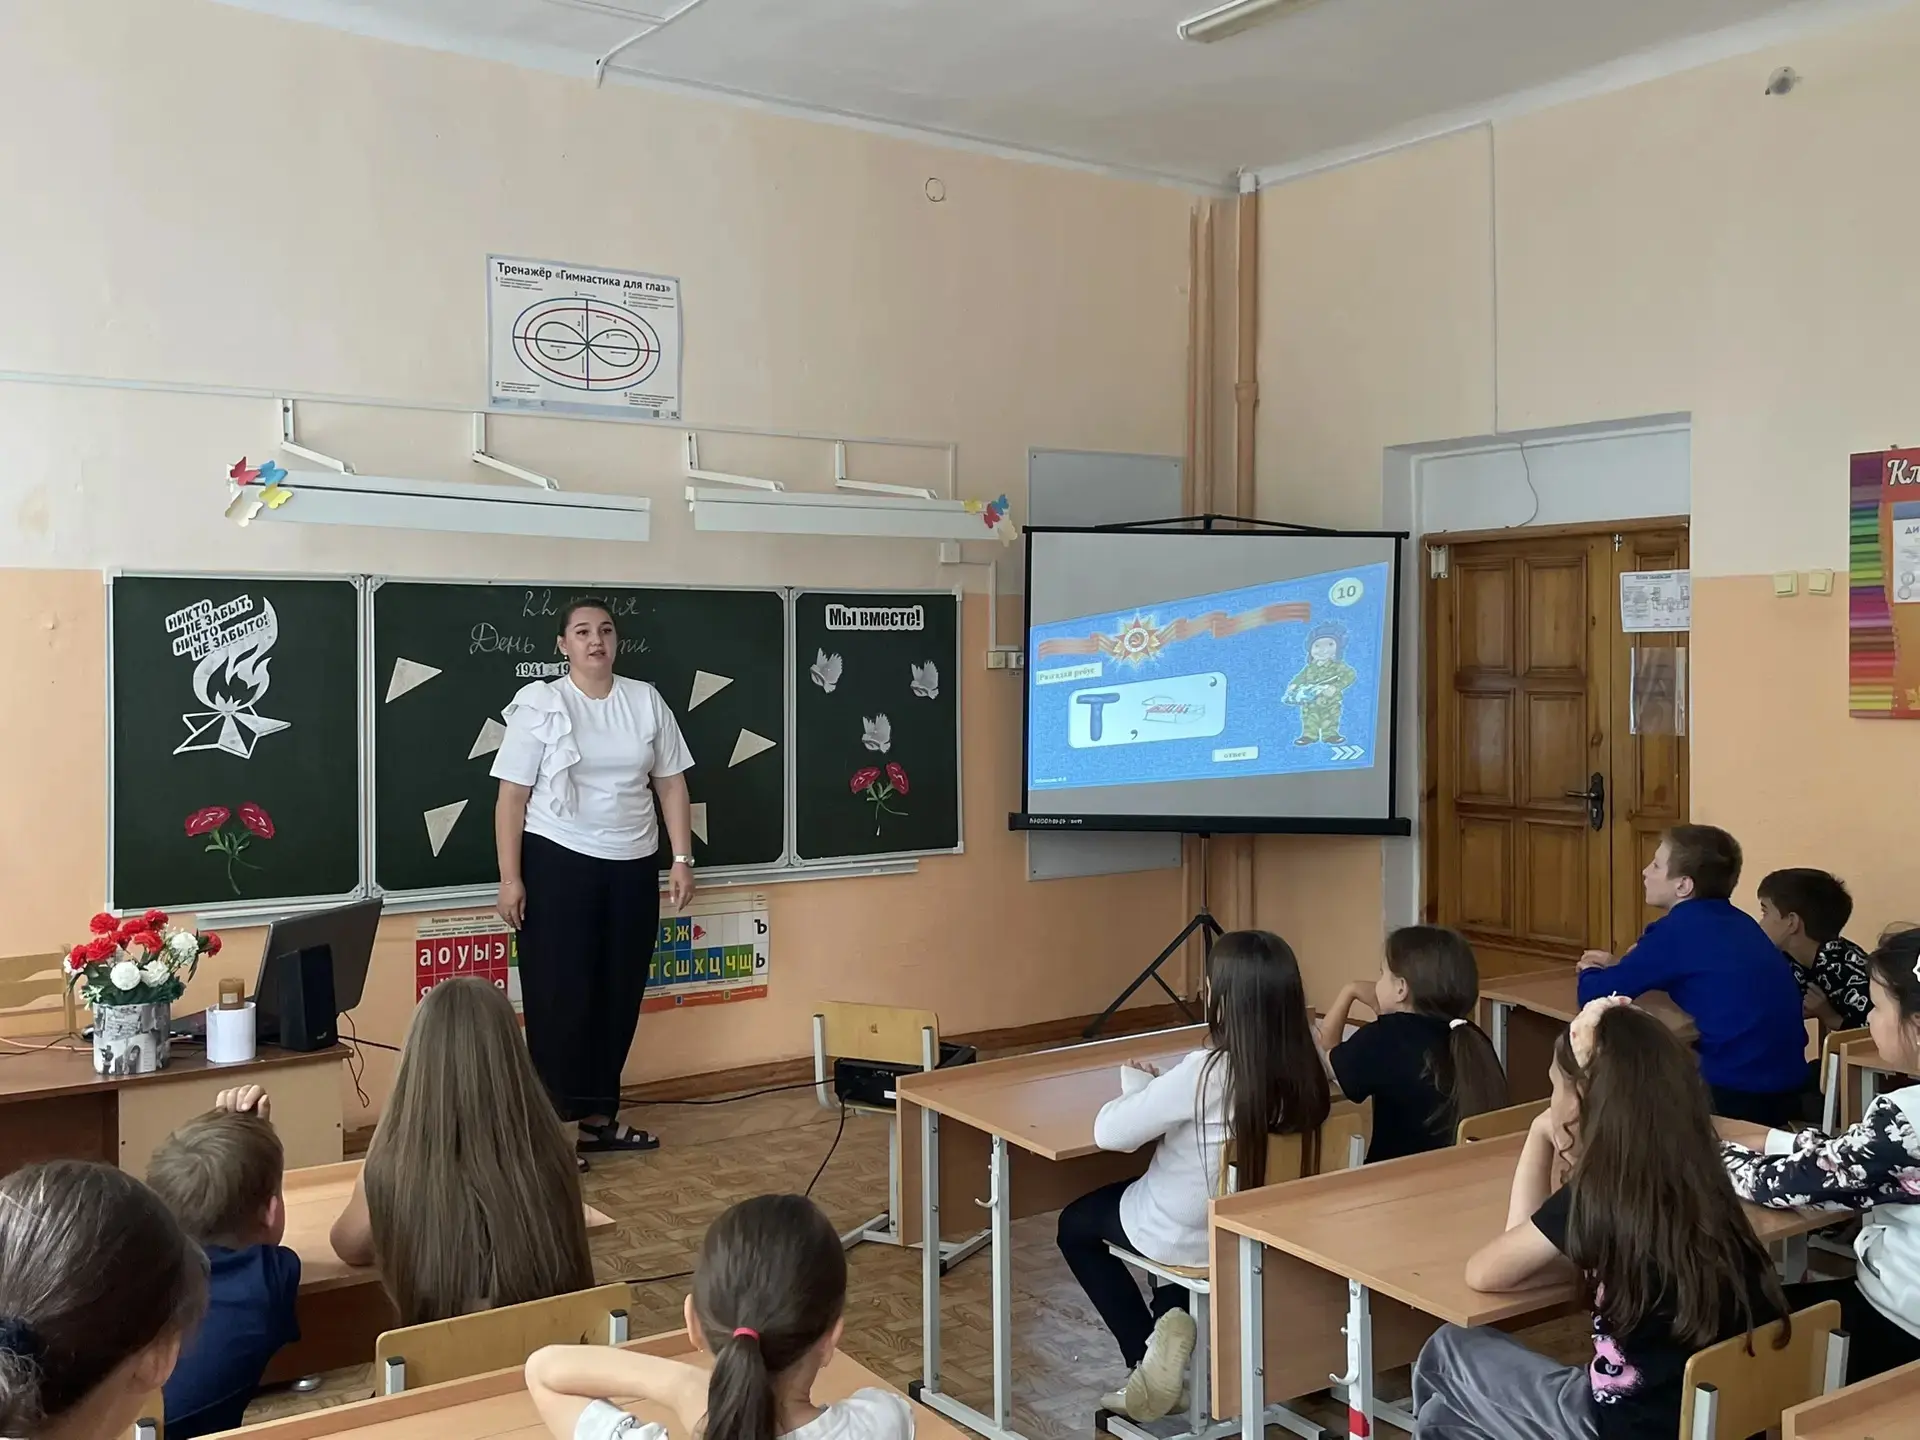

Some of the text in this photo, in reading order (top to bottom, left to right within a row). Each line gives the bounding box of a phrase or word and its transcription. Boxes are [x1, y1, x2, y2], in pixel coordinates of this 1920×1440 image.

[497, 262, 552, 280] Тренажёр
[555, 269, 620, 287] «Гимнастика
[623, 280, 642, 289] для
[645, 282, 671, 292] глаз»
[523, 589, 559, 617] 22
[1337, 585, 1357, 599] 10
[168, 602, 210, 630] НИКТО
[185, 598, 251, 635] НЕ ЗАБЫТ,
[829, 608, 921, 626] Мы вместе!
[175, 626, 218, 653] НИЧТО
[193, 614, 269, 658] НЕ ЗАБЫТО!
[469, 622, 536, 655] День
[518, 663, 570, 676] 1941 19
[1076, 693, 1120, 742] Т
[420, 942, 505, 969] а о у ы э
